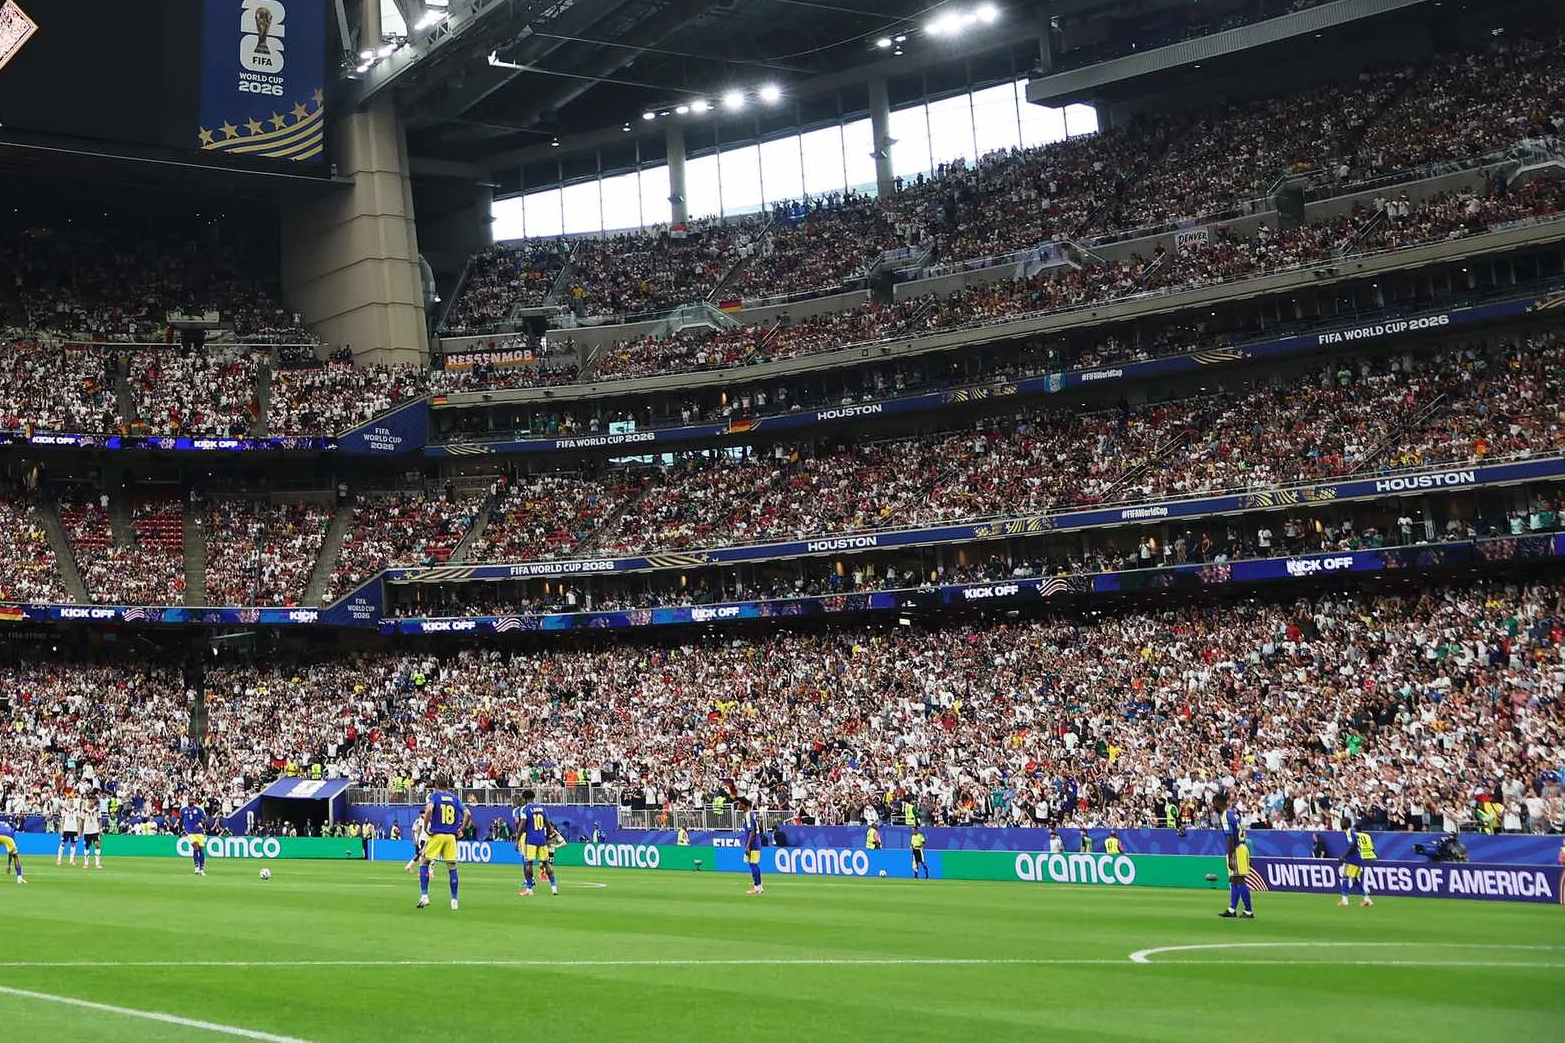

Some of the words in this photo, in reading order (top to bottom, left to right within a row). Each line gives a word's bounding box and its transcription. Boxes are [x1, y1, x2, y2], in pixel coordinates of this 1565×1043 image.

[252, 56, 273, 67] FIFA
[239, 72, 267, 83] WORLD
[268, 75, 284, 85] CUP
[238, 81, 284, 96] 2026
[1178, 231, 1208, 245] DENVER
[1318, 333, 1342, 345] FIFA
[1344, 326, 1383, 341] WORLD
[1385, 322, 1408, 334] CUP
[1409, 315, 1449, 330] 2026
[817, 403, 883, 421] HOUSTON
[363, 434, 388, 443] WORLD
[388, 436, 402, 444] CUP
[375, 428, 390, 436] FIFA
[56, 437, 76, 445] OFF
[370, 442, 394, 450] 2026
[556, 438, 575, 449] FIFA
[576, 436, 606, 447] WORLD
[607, 435, 624, 446] CUP
[624, 432, 655, 443] 2026
[1376, 470, 1475, 492] HOUSTON
[1121, 507, 1168, 519] #FIFAWorldCup
[808, 535, 877, 552] HOUSTON
[510, 565, 530, 576] FIFA
[531, 563, 563, 574] WORLD
[563, 562, 583, 573] CUP
[583, 560, 614, 572] 2026
[1287, 559, 1321, 574] KICK
[1323, 557, 1353, 571] OFF
[965, 587, 993, 599] KICK
[994, 585, 1019, 596] OFF
[60, 608, 89, 617] KICK
[90, 609, 115, 618] OFF
[289, 611, 318, 621] KICK
[691, 607, 718, 620] KICK
[718, 606, 740, 617] OFF
[423, 622, 451, 631] KICK
[452, 621, 476, 630] OFF
[440, 804, 455, 826] 18
[532, 813, 545, 831] 10
[176, 835, 282, 859] aamco
[583, 843, 661, 869] aramco
[774, 847, 870, 877] aramco
[1014, 852, 1136, 885] aramco
[1266, 863, 1335, 893] UNITED
[1339, 865, 1413, 895] ATES
[1415, 868, 1444, 894] OF
[1448, 869, 1553, 898] AMERICA
